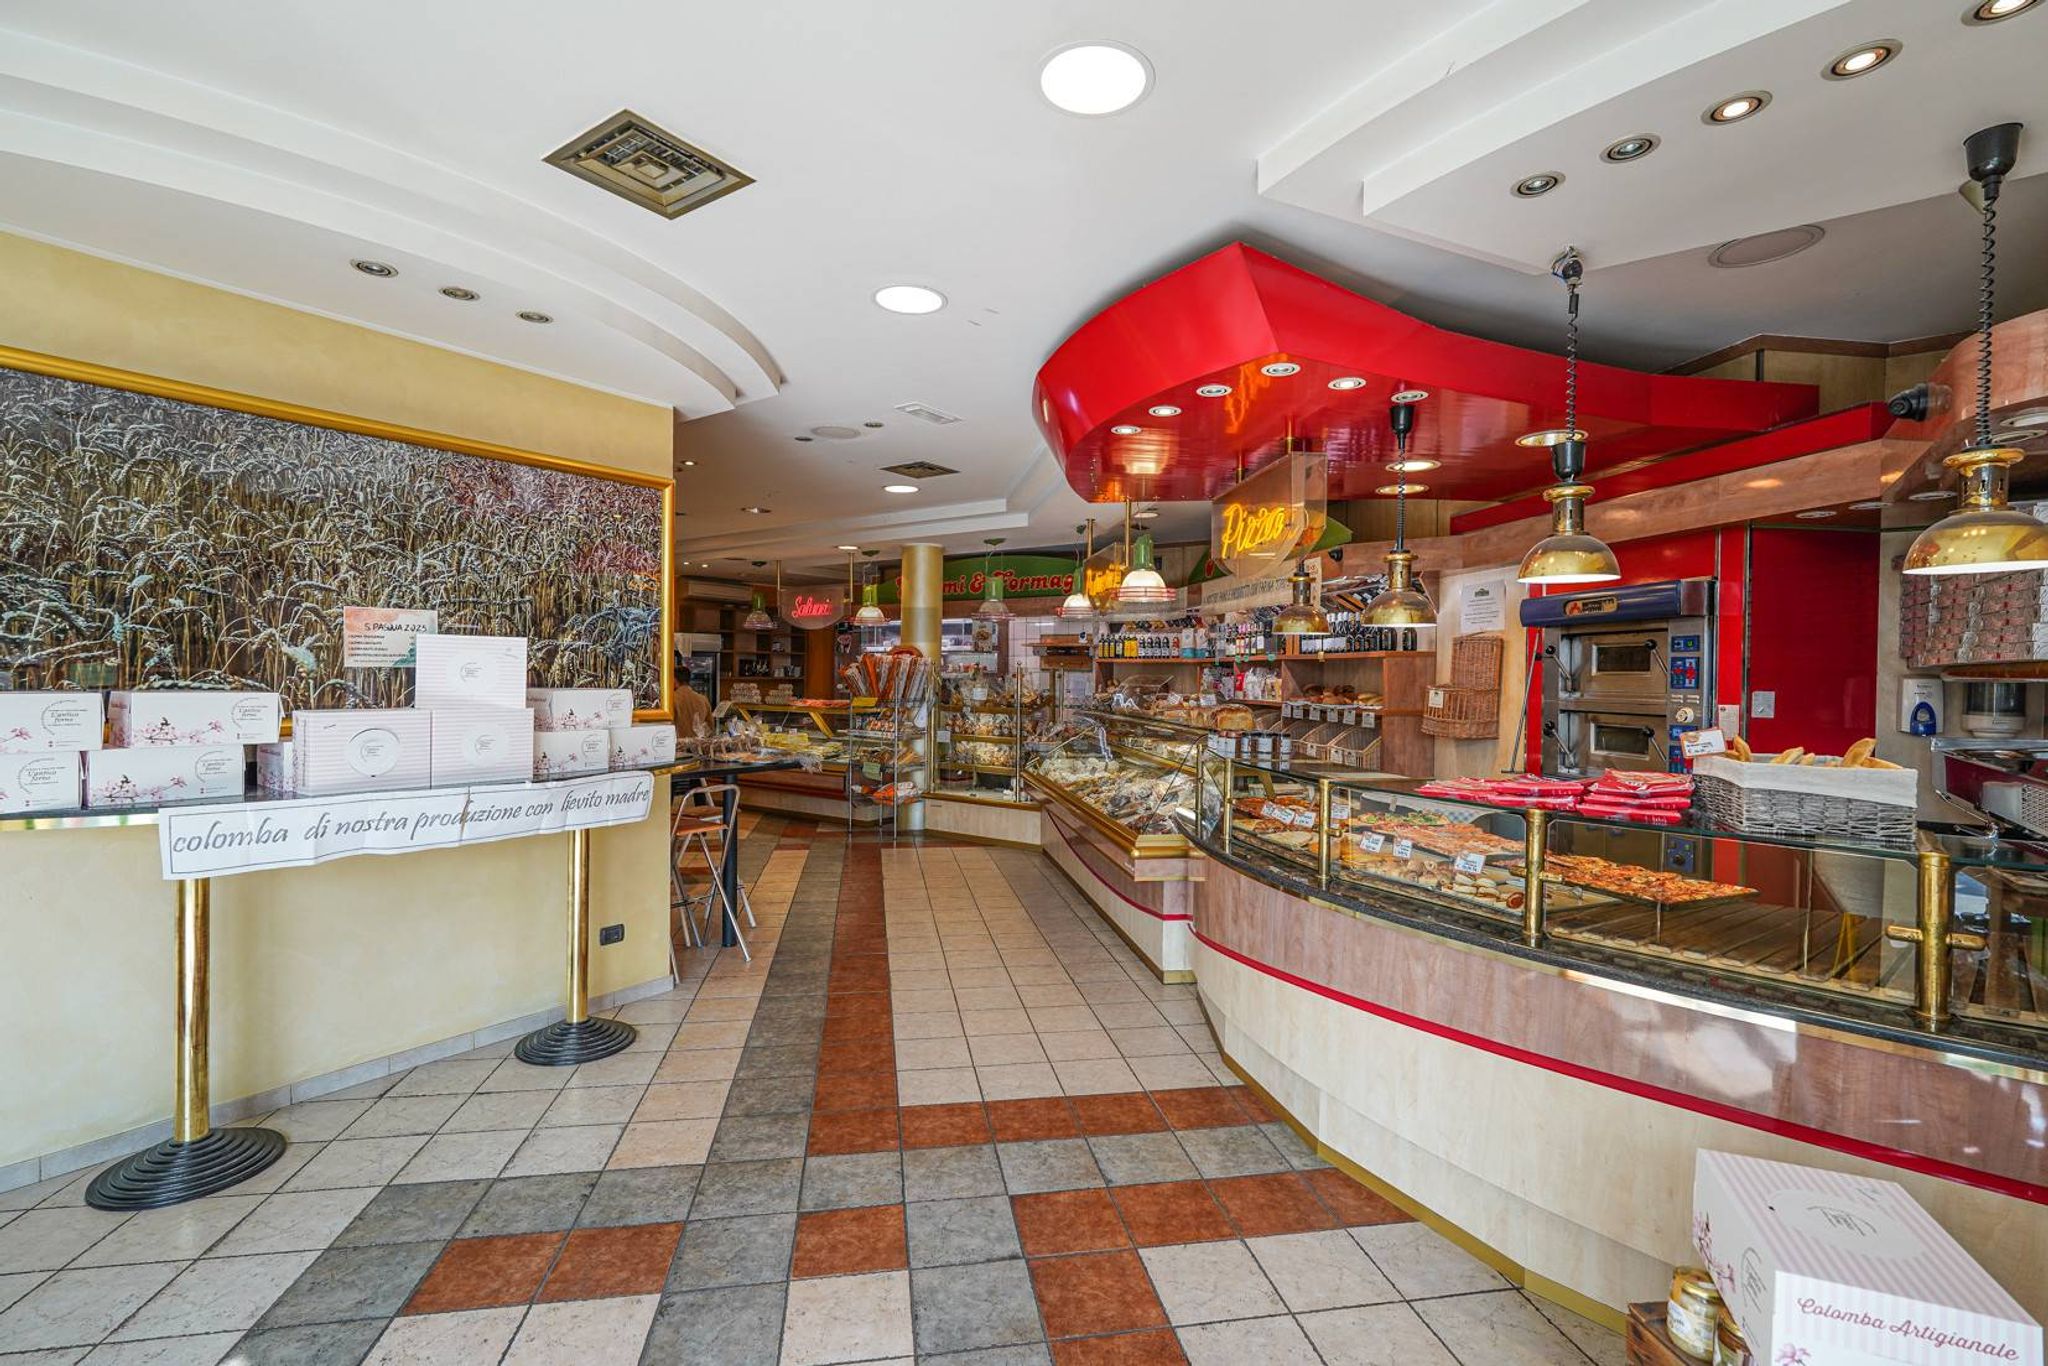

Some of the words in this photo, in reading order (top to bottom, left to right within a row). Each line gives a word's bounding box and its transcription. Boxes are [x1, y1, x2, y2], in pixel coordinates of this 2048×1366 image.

[1222, 503, 1285, 559] Pizza
[969, 571, 986, 593] &
[173, 817, 289, 853] colomba
[304, 811, 331, 841] di
[334, 811, 409, 835] nostra
[410, 799, 522, 840] produzione
[524, 801, 553, 817] con
[561, 790, 602, 811] lievito
[605, 782, 650, 806] madre
[1797, 1298, 1886, 1330] Colomba
[1889, 1320, 2020, 1361] Artigianale
